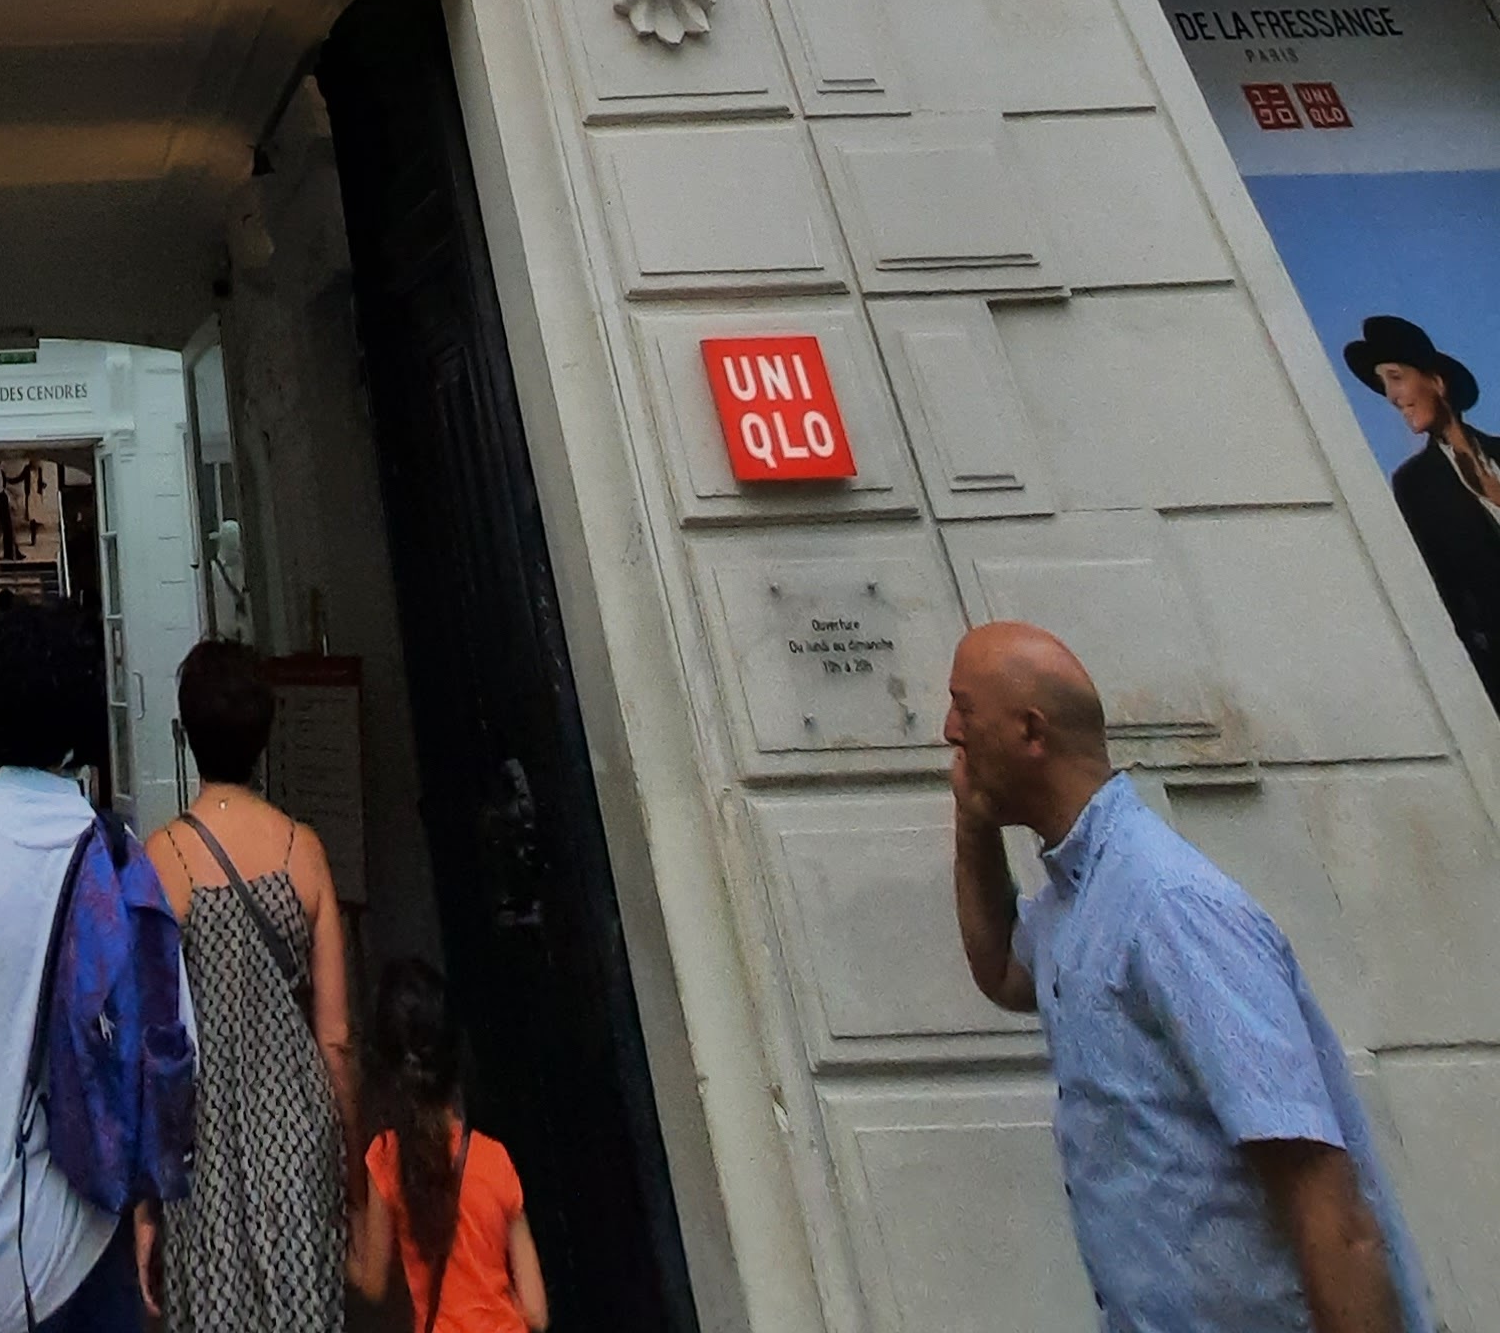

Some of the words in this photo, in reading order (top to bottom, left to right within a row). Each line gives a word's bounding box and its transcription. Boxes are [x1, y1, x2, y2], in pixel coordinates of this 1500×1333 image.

[1175, 13, 1215, 41] DE
[1213, 11, 1255, 40] LA
[1250, 7, 1404, 38] FRESSANGE
[1245, 47, 1300, 63] PARIS
[1301, 88, 1333, 104] UNI
[1309, 107, 1345, 124] QLO
[722, 354, 812, 401] UNI
[0, 386, 23, 402] DES
[26, 383, 88, 401] CENDRES
[740, 410, 834, 469] QLO
[811, 618, 861, 632] Ouverture
